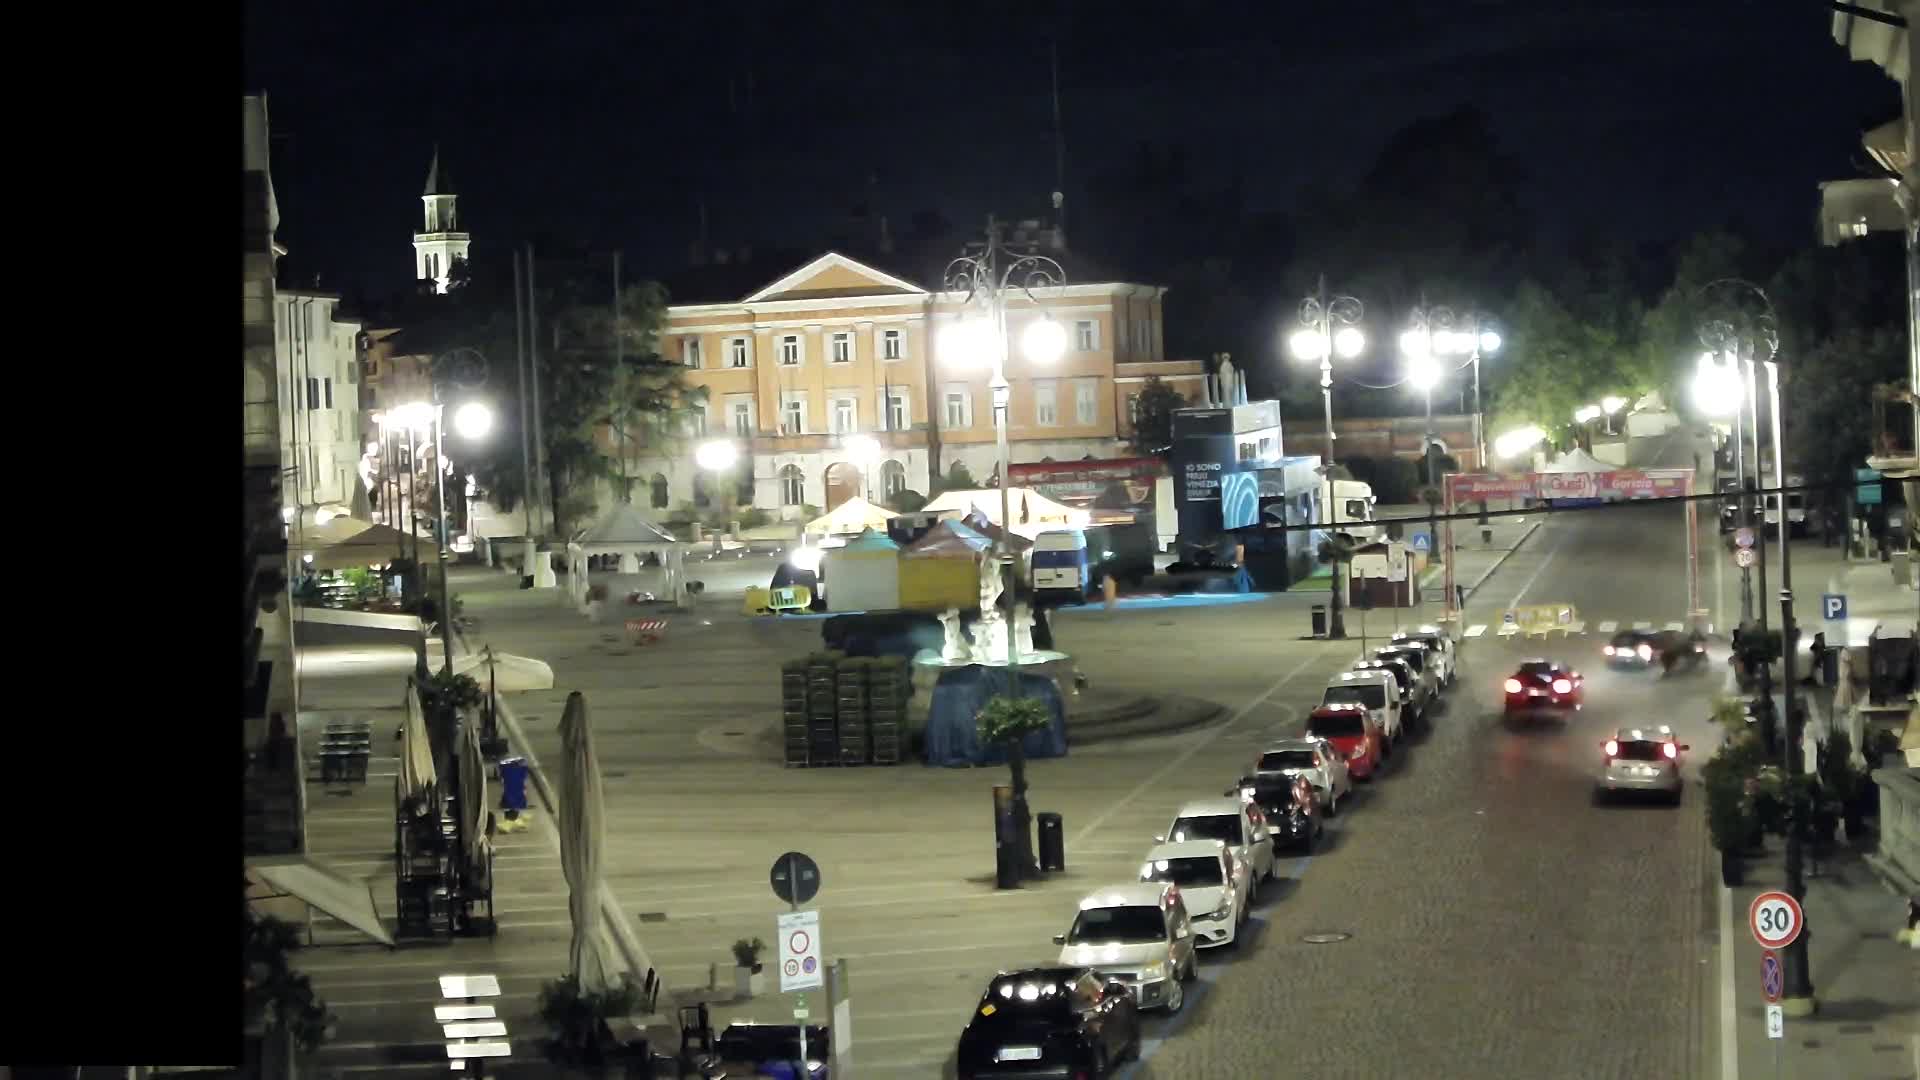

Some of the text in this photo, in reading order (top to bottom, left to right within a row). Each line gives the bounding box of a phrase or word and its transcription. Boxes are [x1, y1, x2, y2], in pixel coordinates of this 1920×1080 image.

[1196, 463, 1221, 471] SONO
[1827, 598, 1842, 618] P
[1760, 907, 1789, 932] 30
